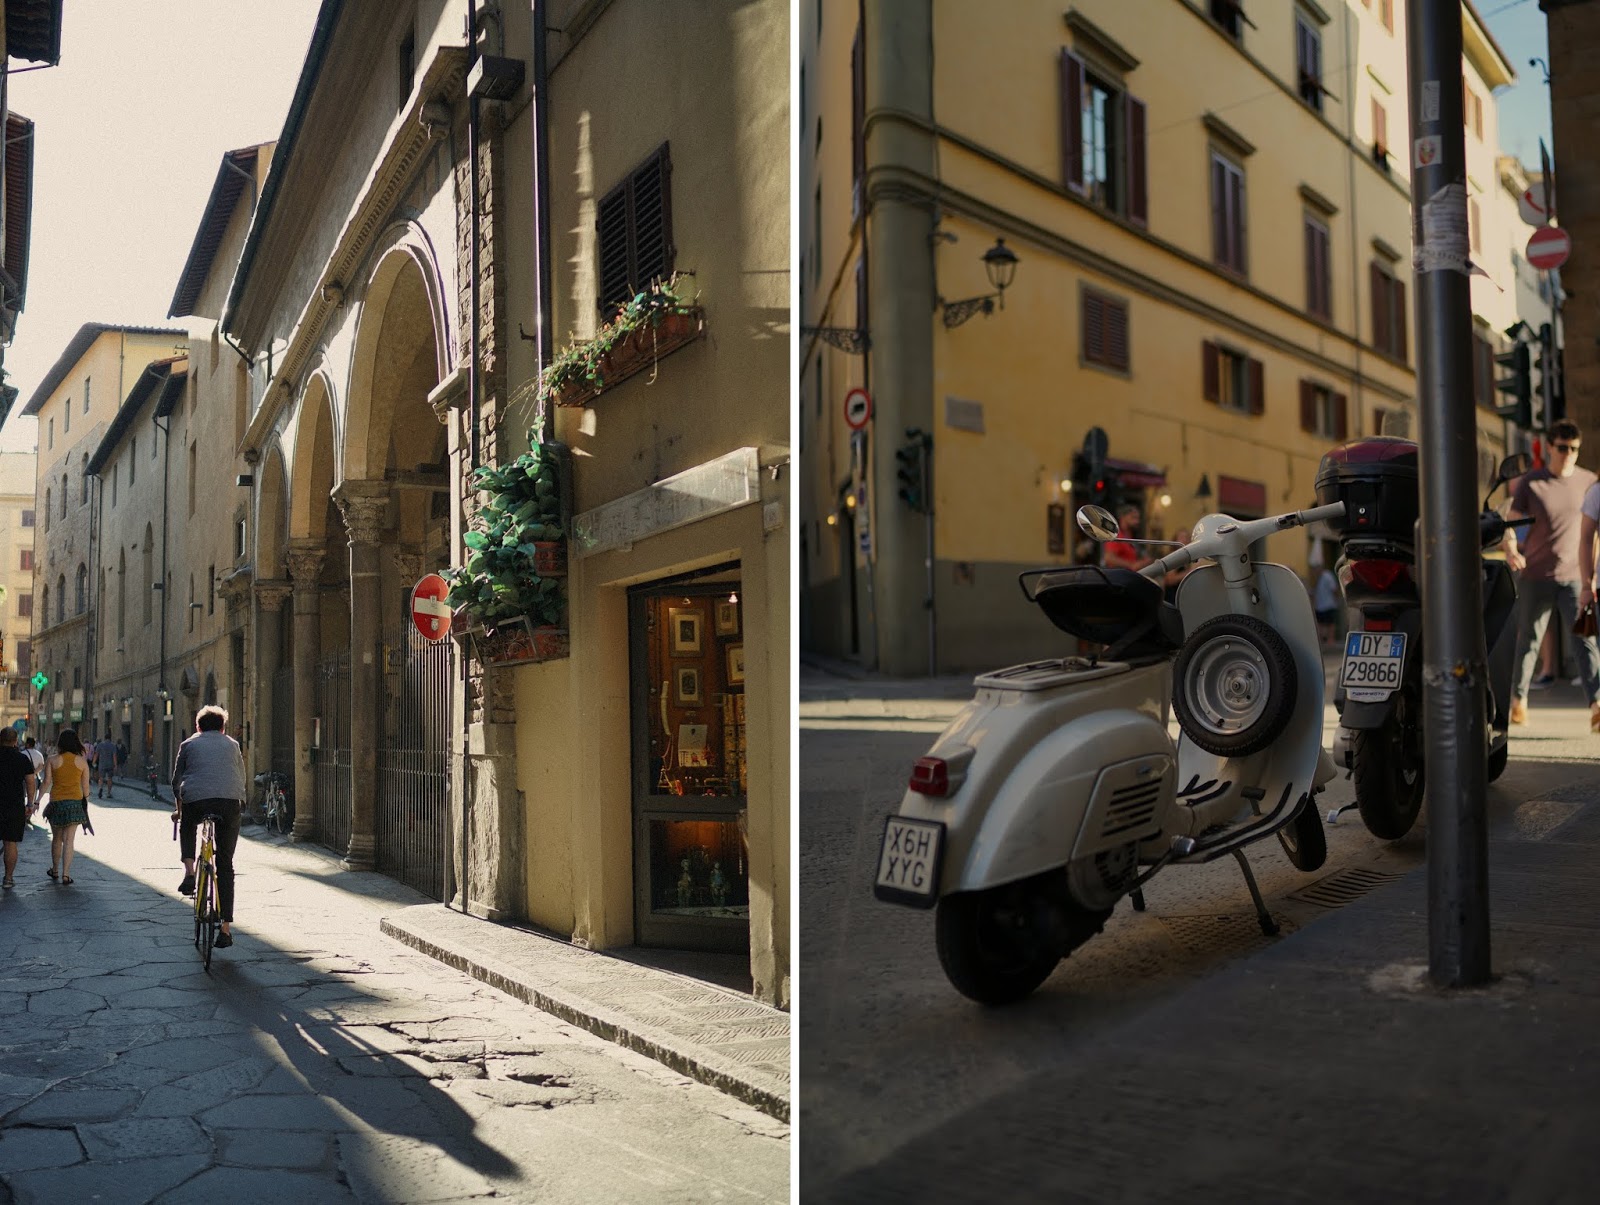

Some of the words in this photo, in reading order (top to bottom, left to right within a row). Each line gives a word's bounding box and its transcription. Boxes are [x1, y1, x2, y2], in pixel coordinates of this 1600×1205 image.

[1360, 635, 1383, 656] DY
[1390, 646, 1400, 657] FI
[1346, 661, 1398, 683] 29866
[890, 826, 931, 859] X6H
[886, 855, 925, 888] XYG
